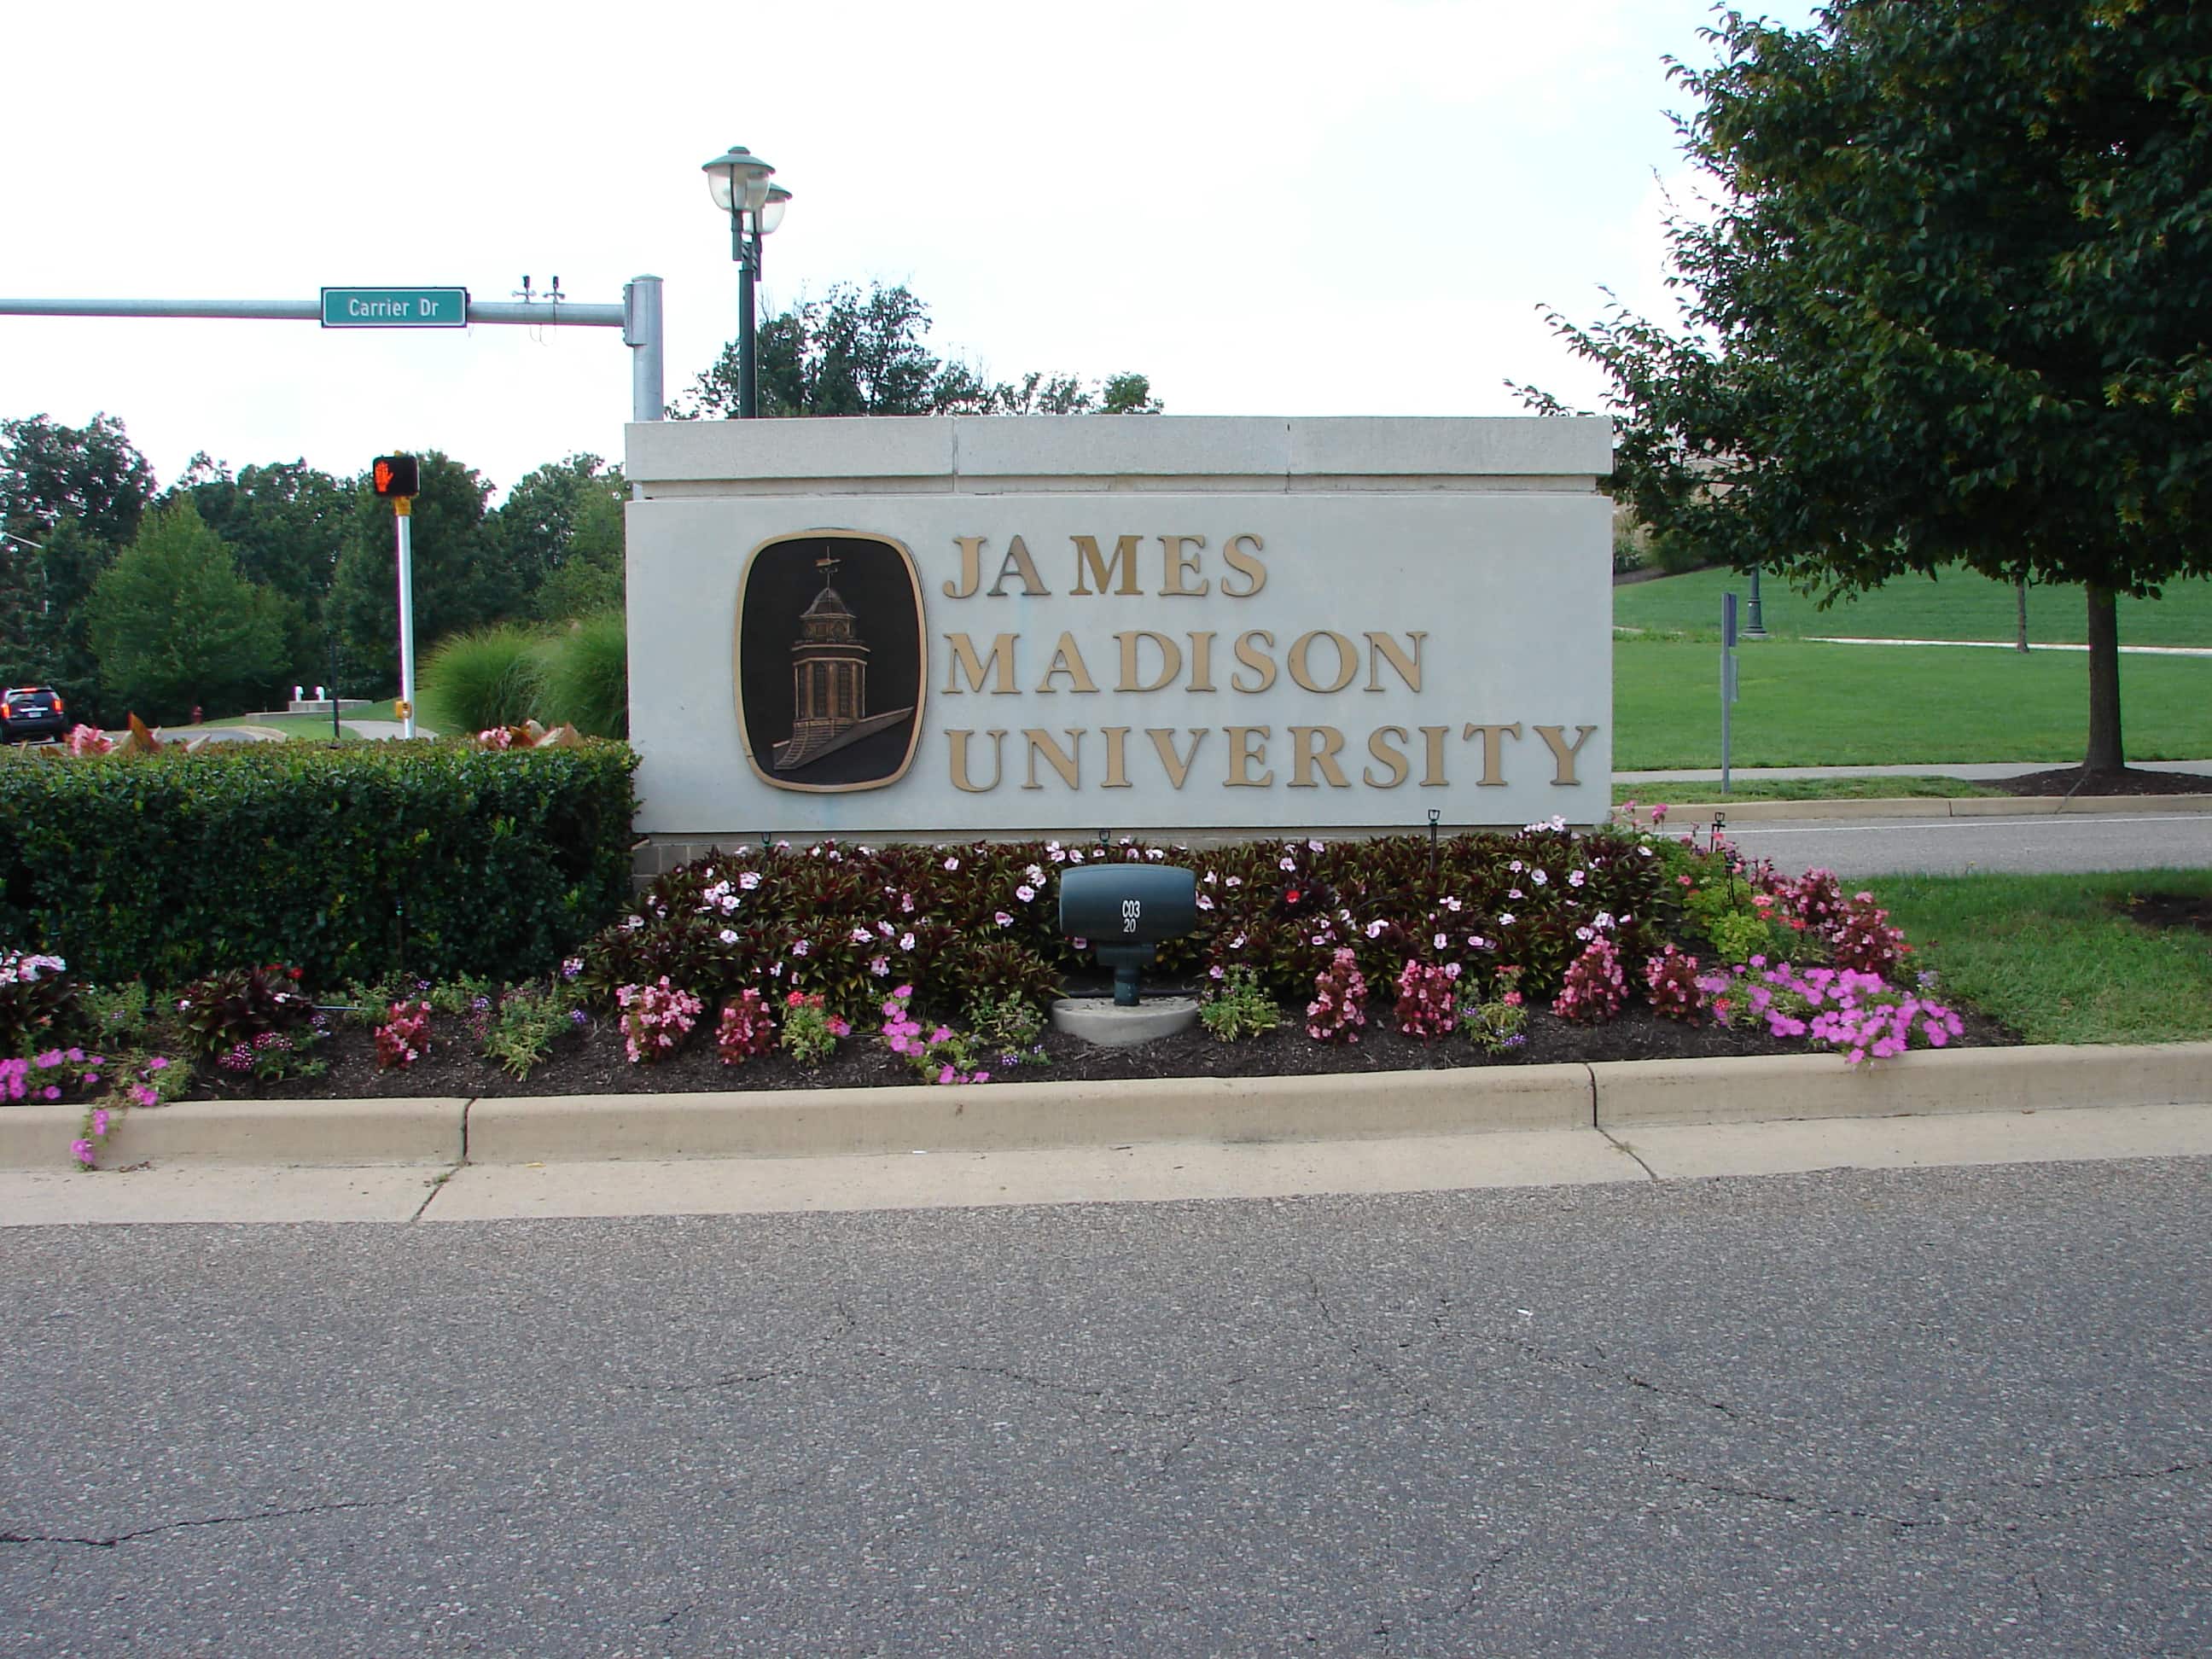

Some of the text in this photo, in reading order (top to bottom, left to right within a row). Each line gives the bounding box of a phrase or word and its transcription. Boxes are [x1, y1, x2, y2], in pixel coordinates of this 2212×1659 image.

[350, 298, 439, 316] Carrier Dr
[942, 533, 1267, 598] JAMES
[942, 630, 1427, 694] MADISON
[944, 722, 1598, 792] UNIVERSITY
[1123, 918, 1137, 933] 20
